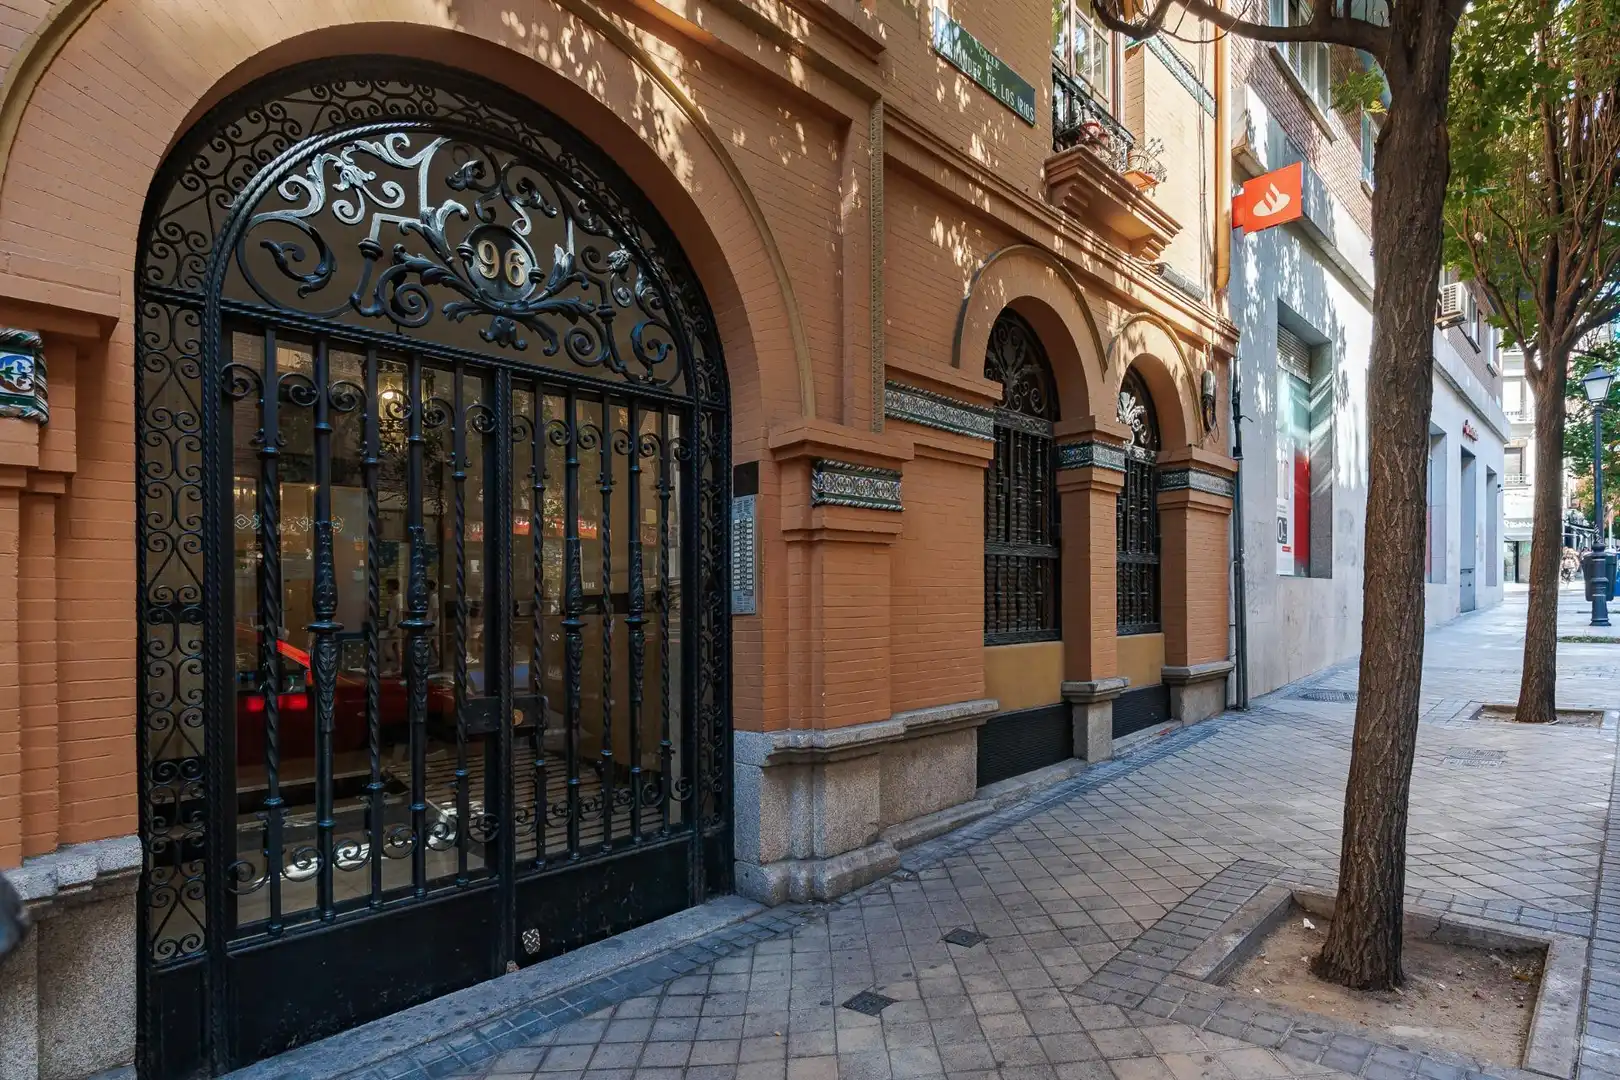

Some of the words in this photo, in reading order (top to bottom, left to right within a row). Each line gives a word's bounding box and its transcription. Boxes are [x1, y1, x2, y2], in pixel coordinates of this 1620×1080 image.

[978, 46, 1000, 70] CALLE
[987, 73, 997, 93] DE
[1000, 84, 1016, 106] LOS
[1017, 95, 1035, 122] RIOS
[477, 239, 525, 286] 96
